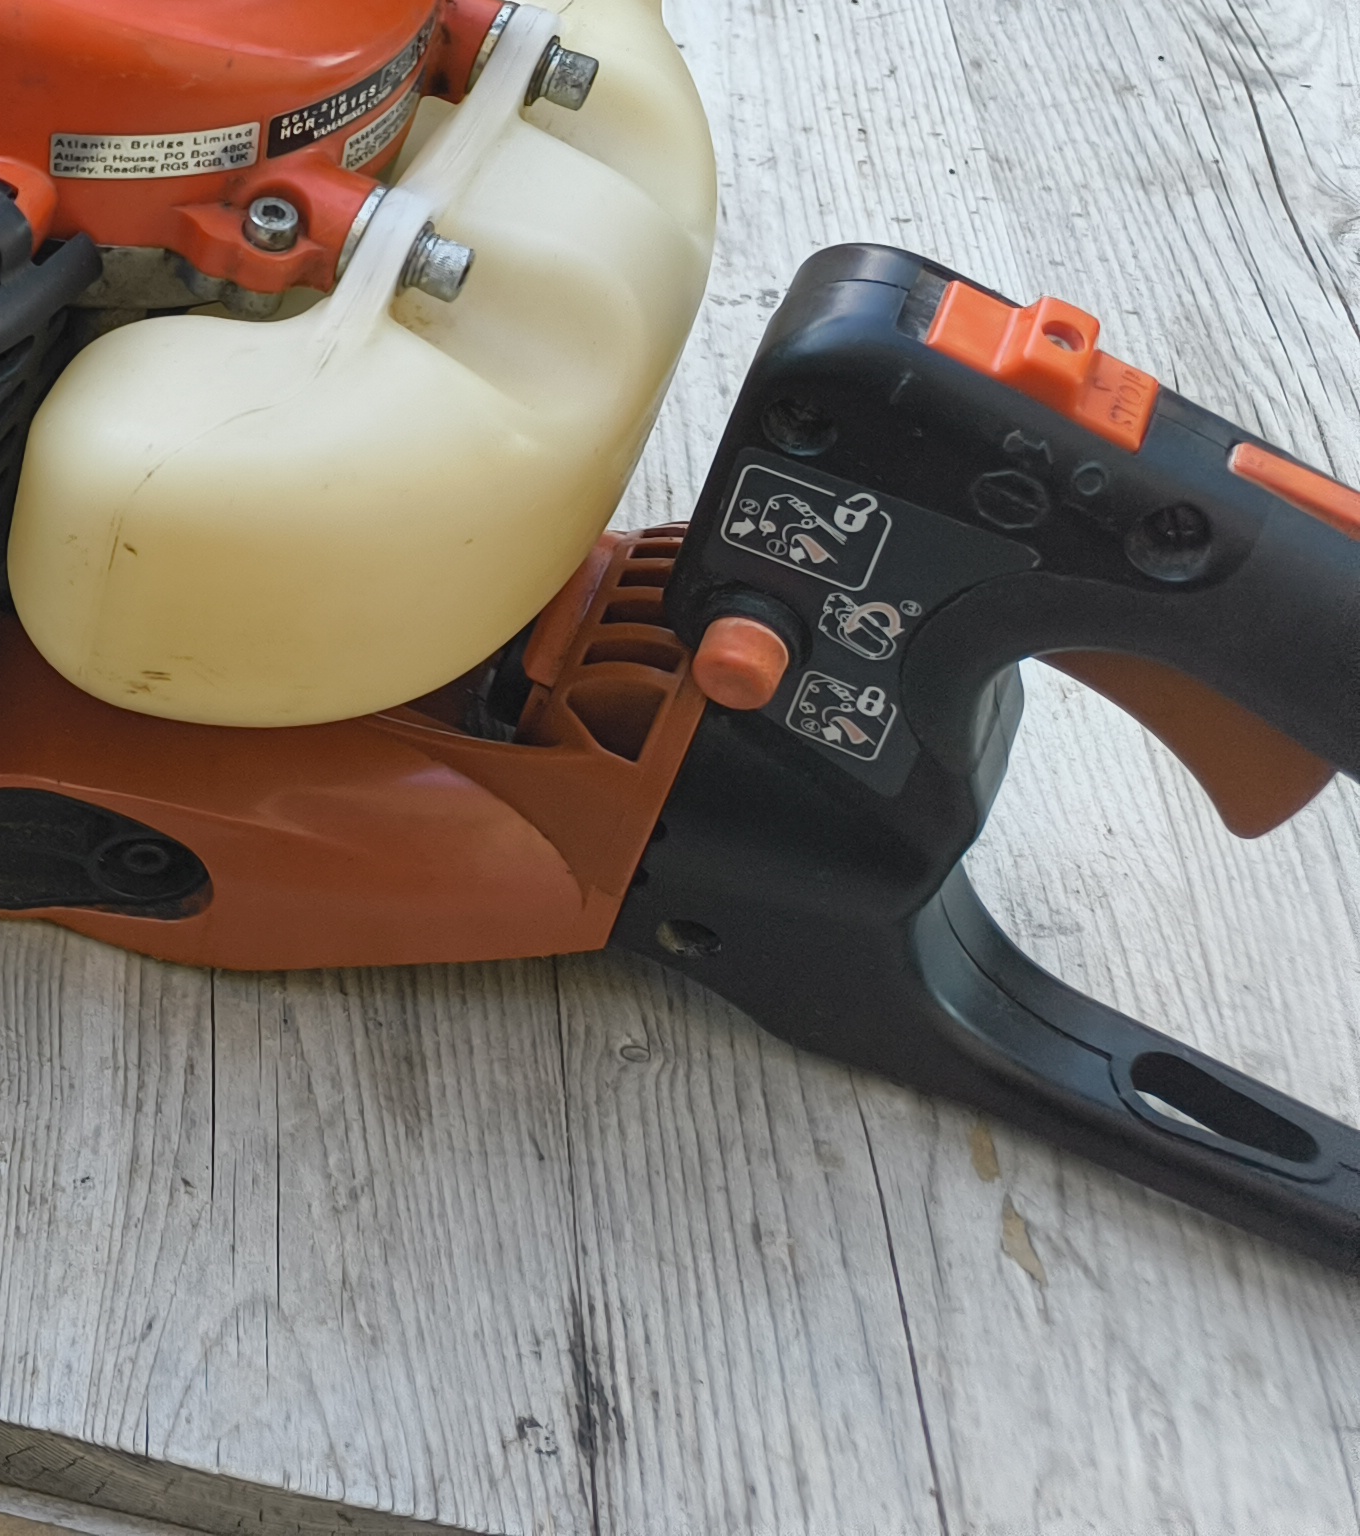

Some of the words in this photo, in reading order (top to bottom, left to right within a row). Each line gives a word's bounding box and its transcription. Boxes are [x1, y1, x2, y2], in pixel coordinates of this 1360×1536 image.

[280, 84, 377, 140] HCR-161ES
[54, 138, 121, 150] Atlantic
[131, 139, 184, 150] Bridge
[193, 128, 253, 146] Limited
[54, 151, 107, 163] Atlantic
[164, 151, 185, 162] PO
[190, 149, 216, 160] Box
[103, 165, 155, 174] Reading
[230, 152, 249, 164] UK
